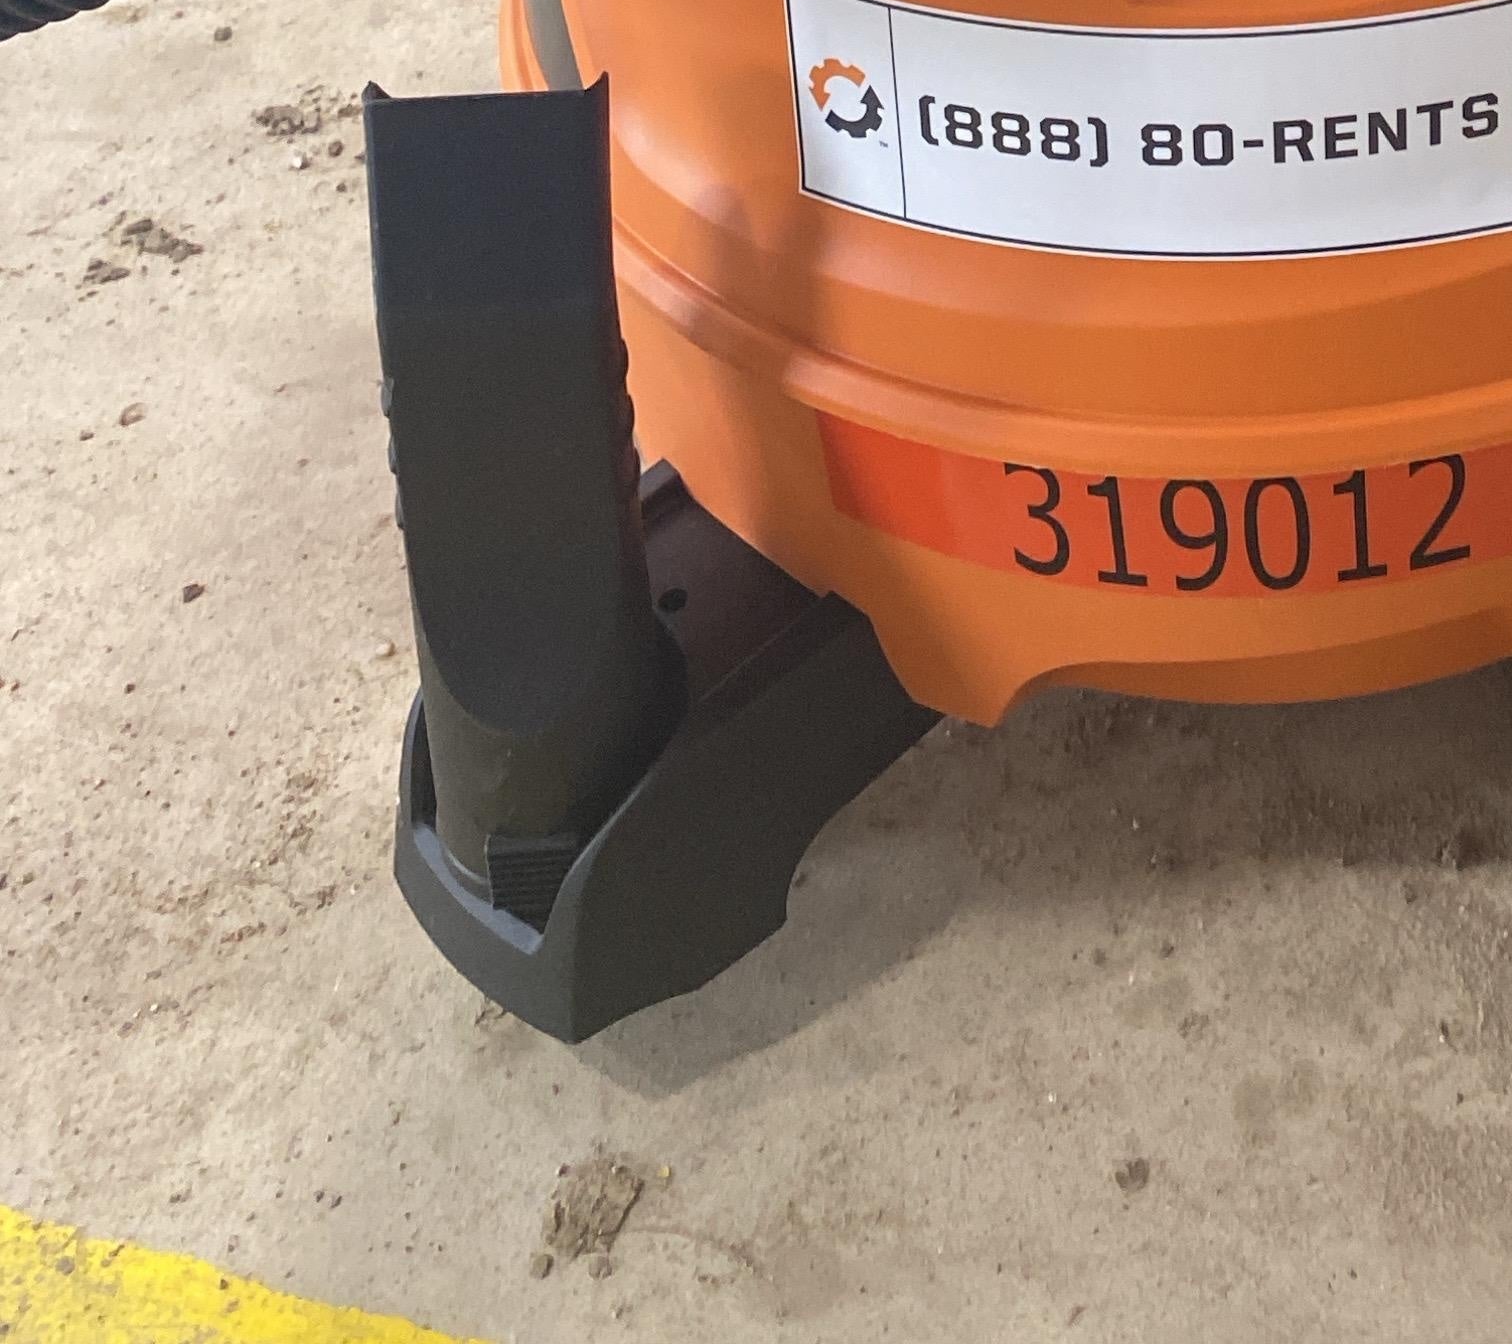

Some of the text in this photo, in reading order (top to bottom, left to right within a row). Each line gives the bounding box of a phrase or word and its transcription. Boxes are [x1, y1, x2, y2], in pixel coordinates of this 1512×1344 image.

[919, 93, 1499, 167] (888) 80-RENTS
[1004, 453, 1471, 591] 319012
